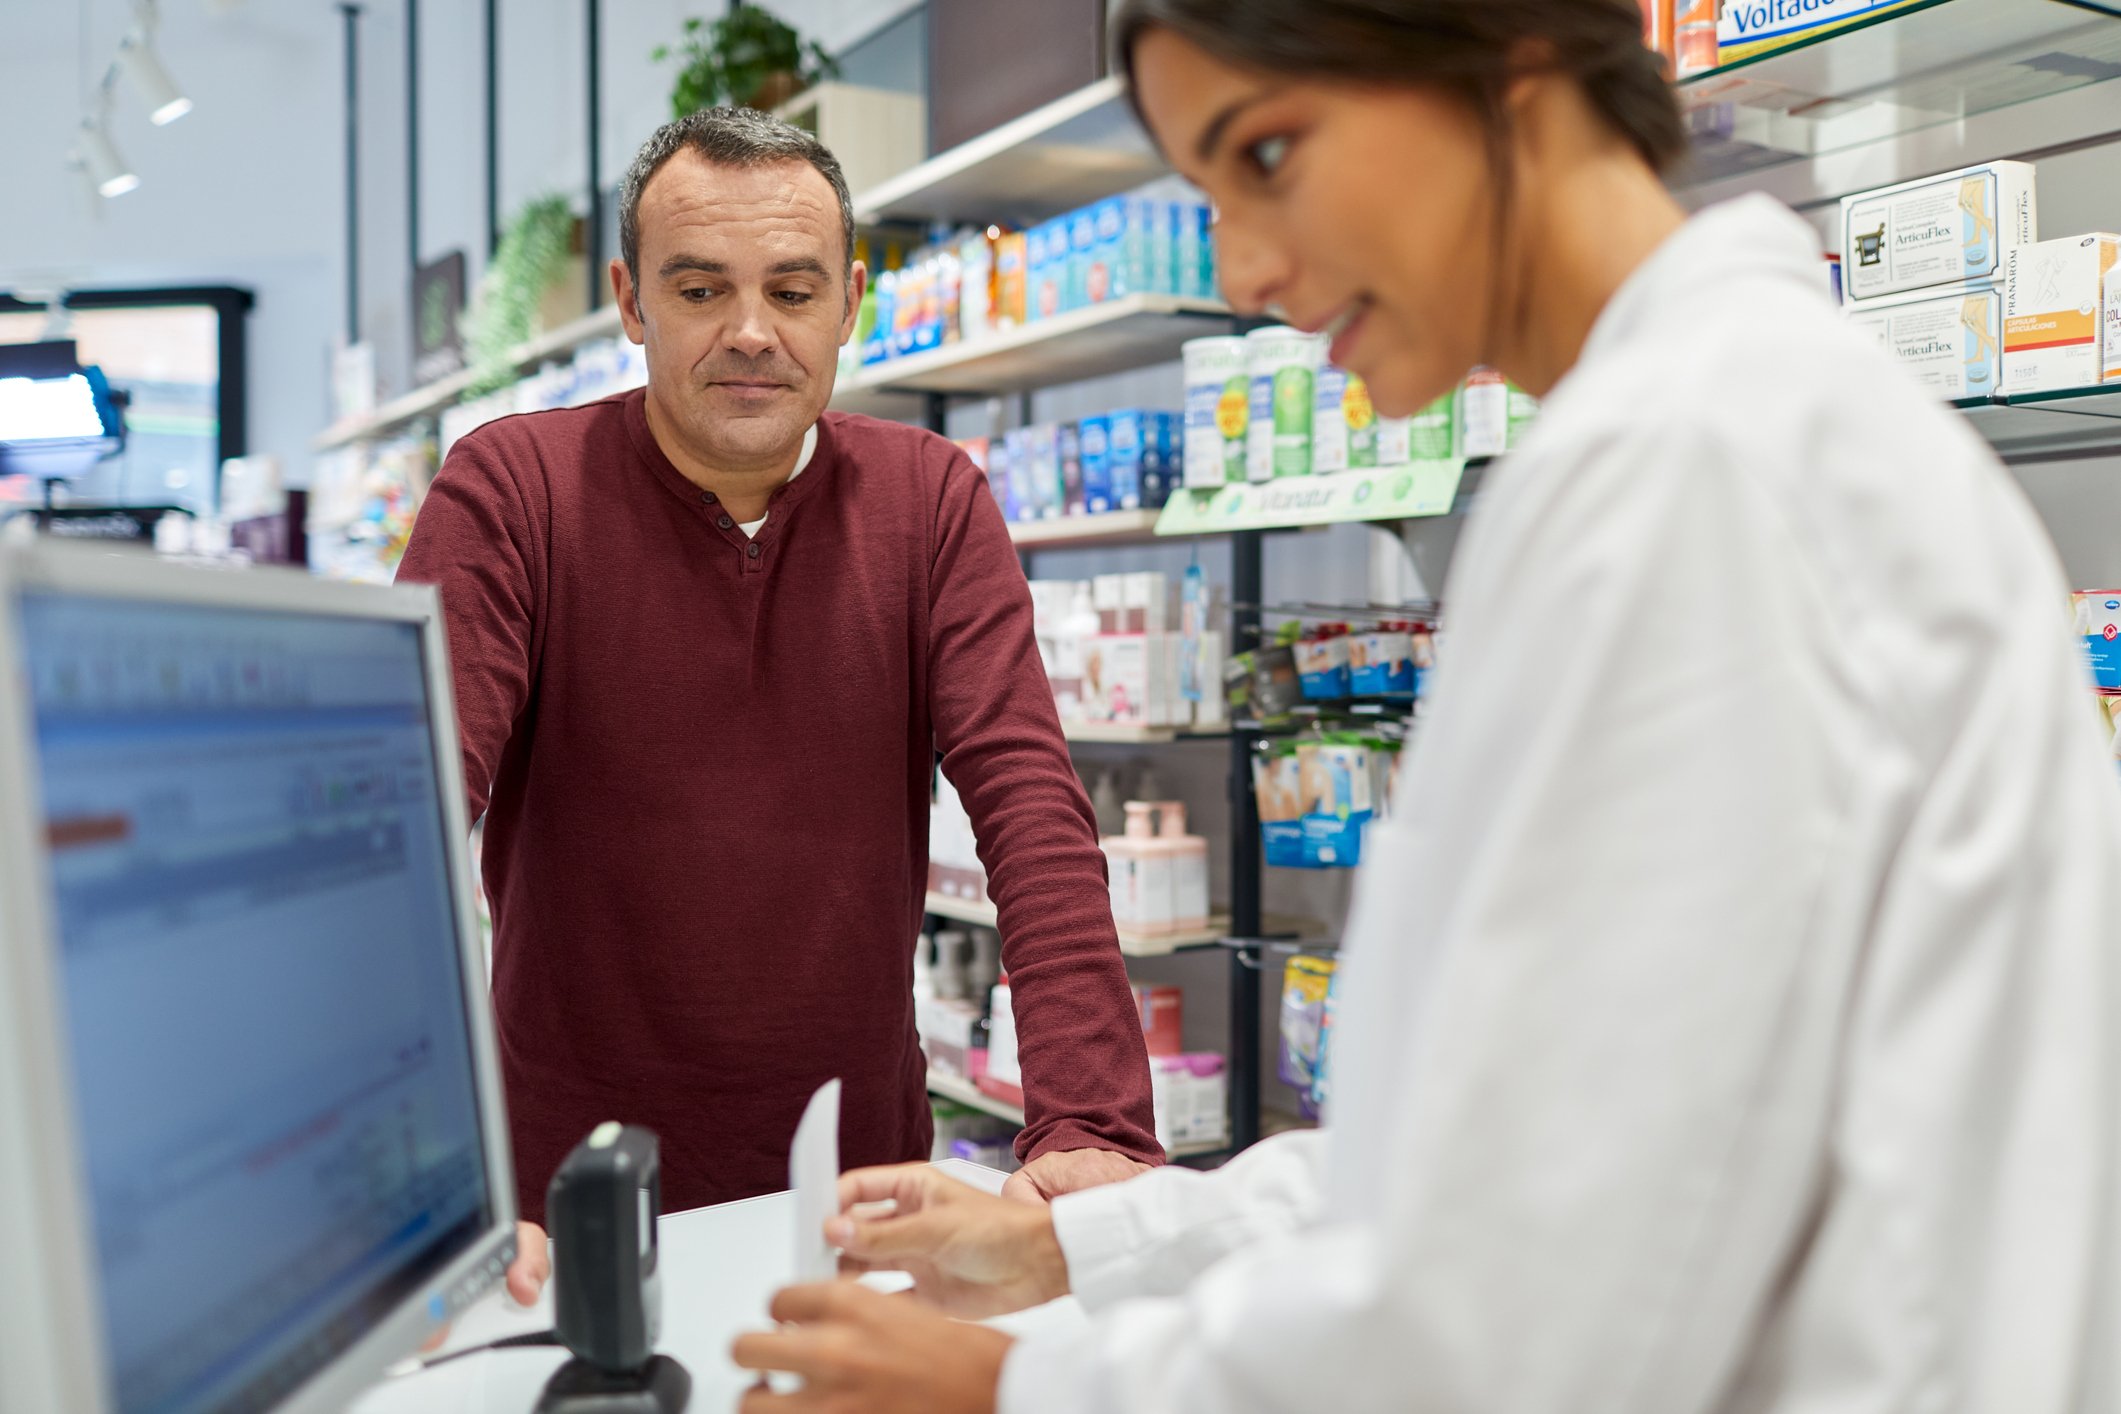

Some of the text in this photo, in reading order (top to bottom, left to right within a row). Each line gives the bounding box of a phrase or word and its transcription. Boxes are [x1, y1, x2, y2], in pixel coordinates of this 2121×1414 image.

[2021, 190, 2029, 243] rticuFlex
[1896, 226, 1952, 245] ArticuFlex
[1896, 341, 1952, 356] ArticuFlex
